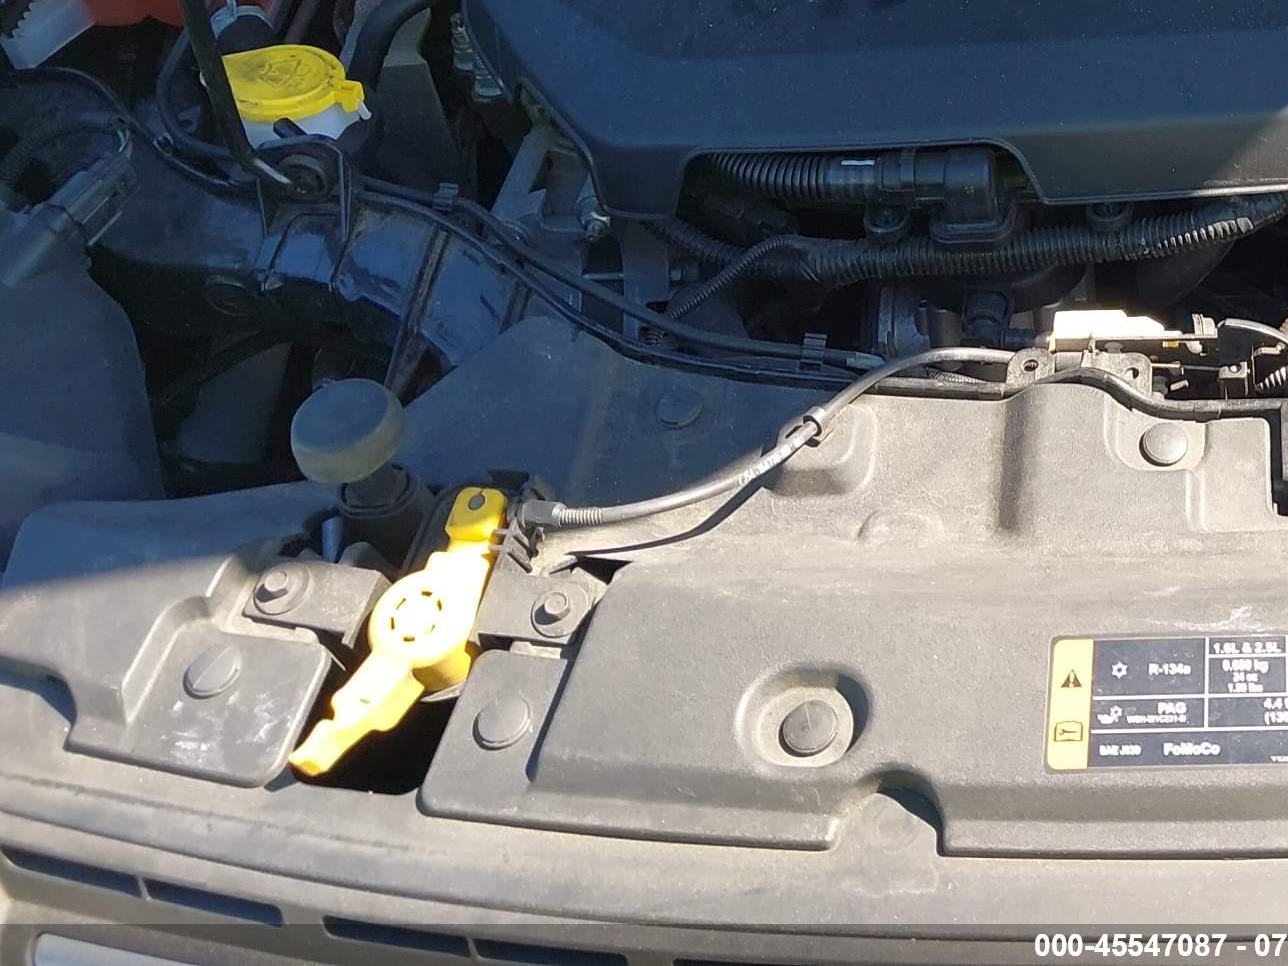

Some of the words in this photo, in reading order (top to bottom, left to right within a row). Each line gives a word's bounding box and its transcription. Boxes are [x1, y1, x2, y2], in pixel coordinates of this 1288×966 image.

[1242, 641, 1253, 653] &
[1148, 663, 1192, 675] R-134a
[1158, 701, 1187, 715] PAG
[1264, 697, 1283, 710] 4.4
[1163, 741, 1222, 757] FoMoCo
